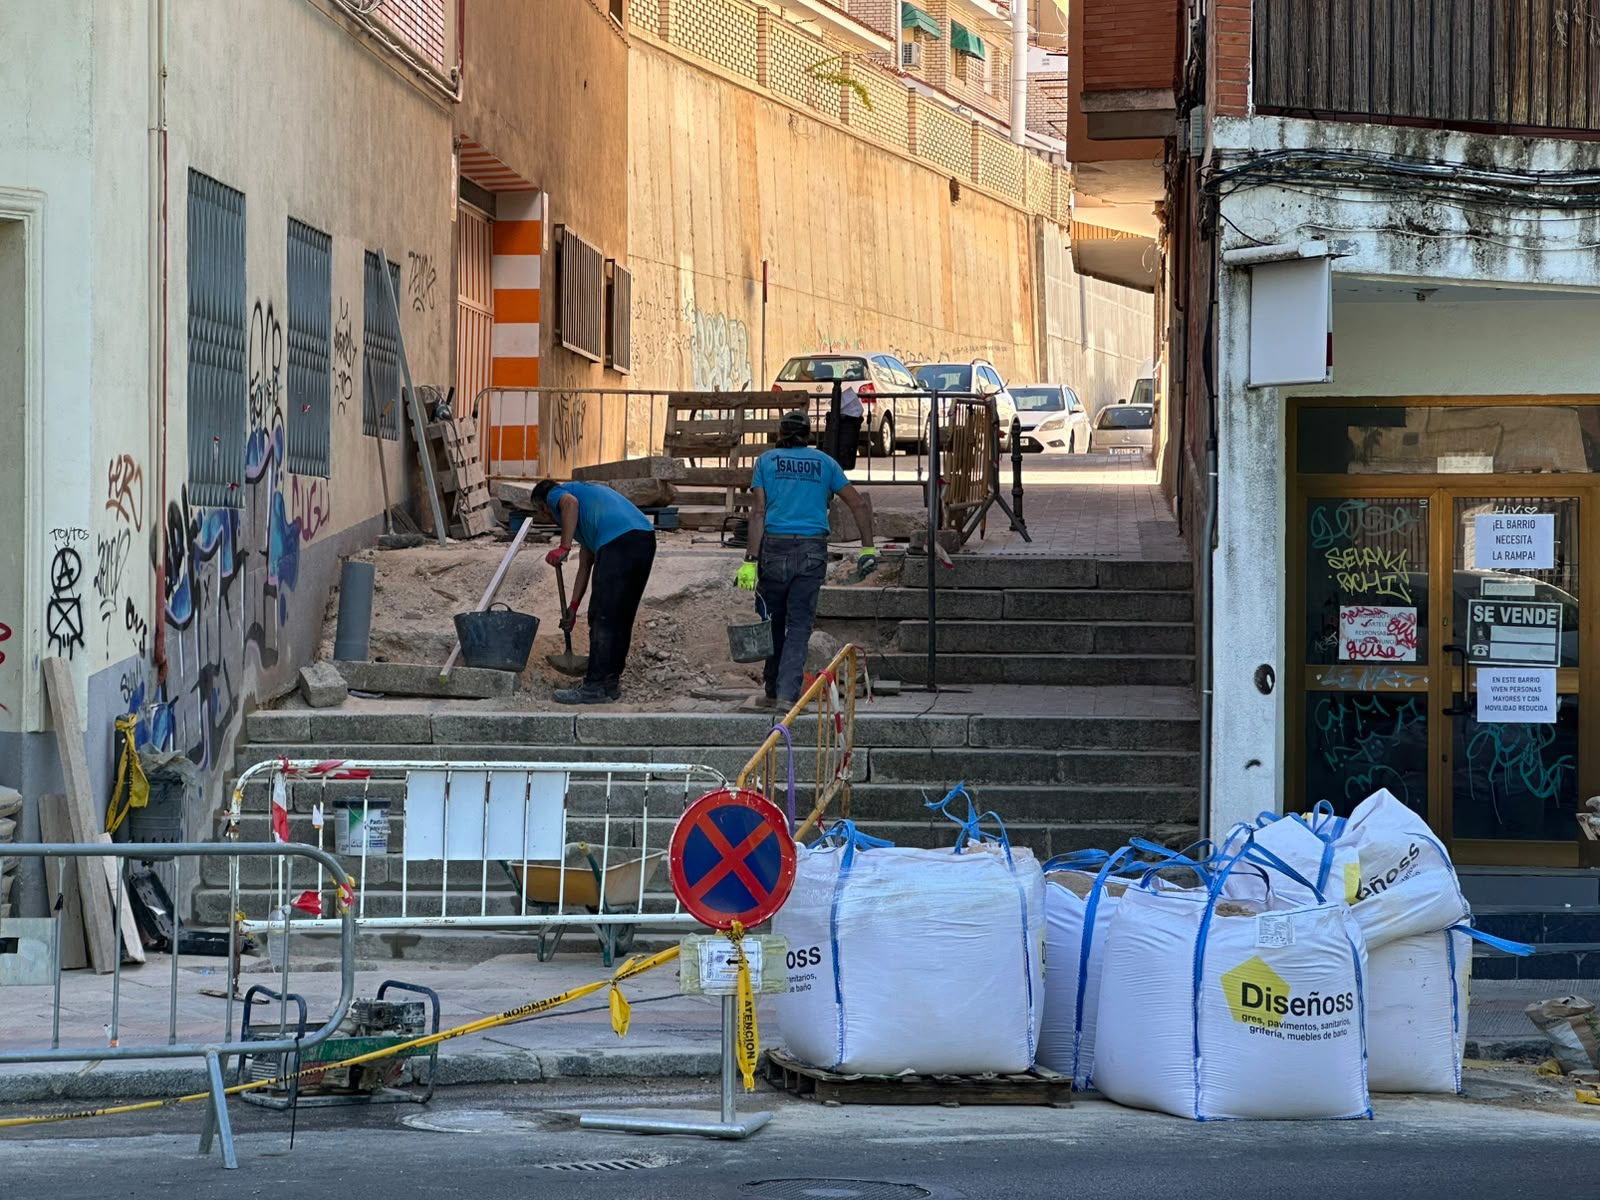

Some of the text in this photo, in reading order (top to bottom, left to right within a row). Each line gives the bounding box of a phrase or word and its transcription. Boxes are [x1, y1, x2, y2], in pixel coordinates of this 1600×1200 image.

[1506, 519, 1536, 530] BARRIO
[1495, 535, 1533, 545] NECESITA
[1492, 550, 1536, 561] LA RAMPA!
[1473, 605, 1558, 625] SE VENDE
[1492, 676, 1541, 684] EN ESTE BARRIO
[1241, 981, 1354, 1017] Diseñoss
[1241, 1013, 1351, 1032] gres, pavimentos, sanitarios,
[744, 1000, 756, 1060] ATENCION
[1287, 1031, 1322, 1041] muebles
[1323, 1030, 1332, 1040] de
